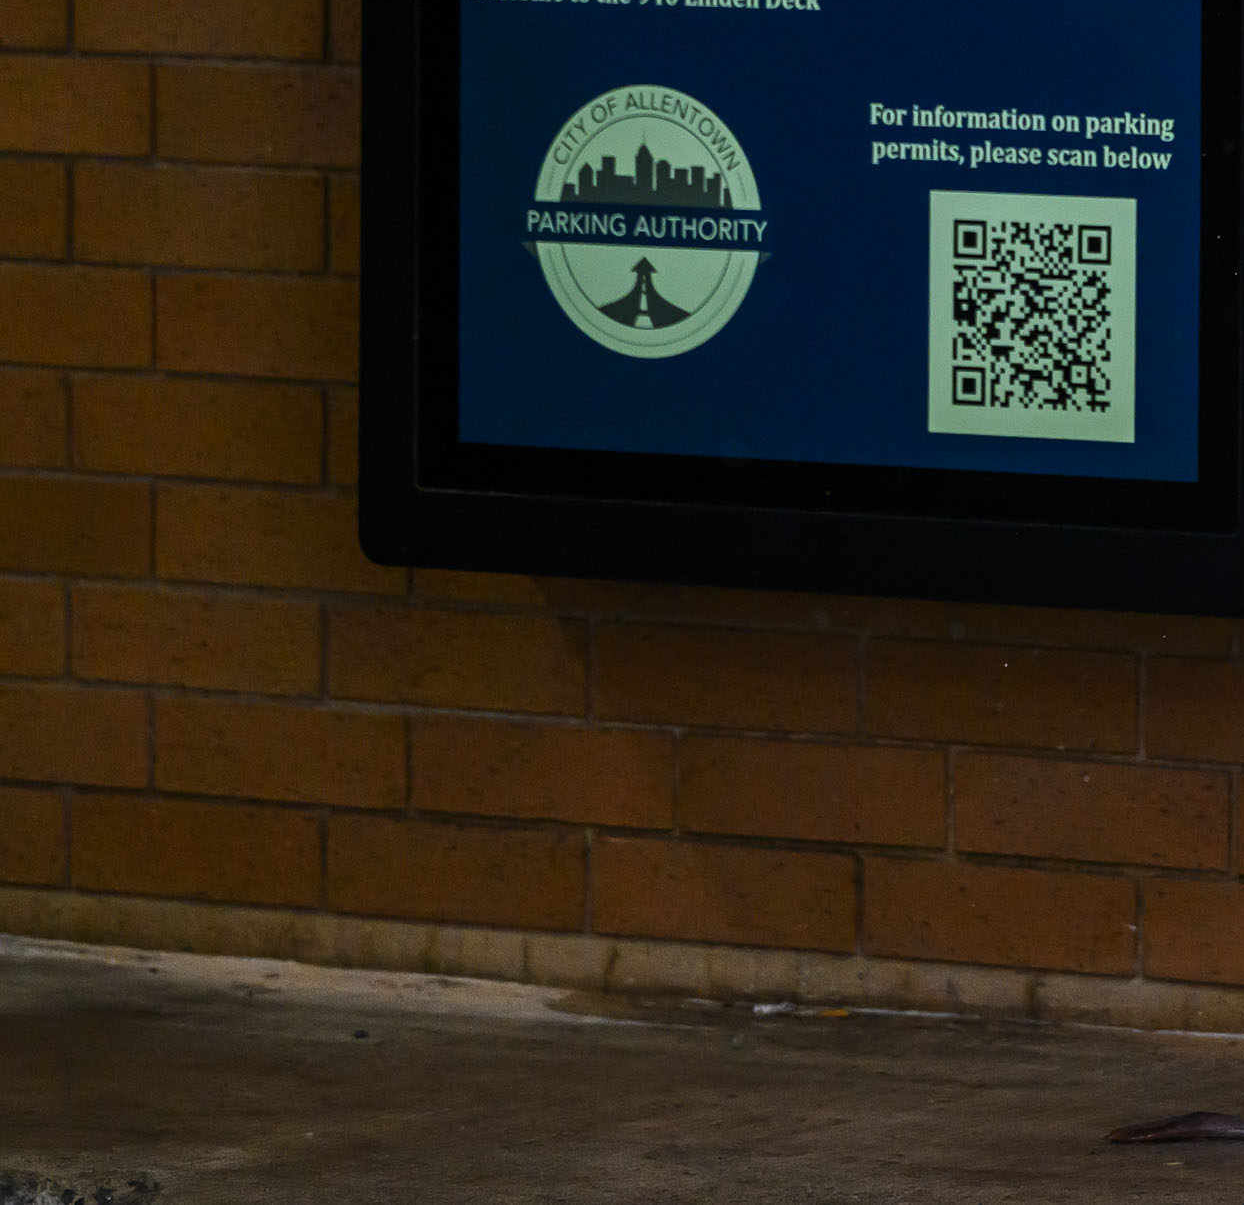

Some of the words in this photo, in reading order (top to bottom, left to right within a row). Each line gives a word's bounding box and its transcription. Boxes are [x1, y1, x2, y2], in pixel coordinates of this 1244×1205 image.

[553, 122, 589, 166] CITY
[591, 98, 620, 125] OF
[625, 92, 741, 171] ALLENTOWN
[871, 103, 907, 125] For
[913, 105, 1045, 131] information
[1052, 115, 1079, 132] on
[1086, 112, 1174, 141] parking
[873, 139, 964, 165] permits,
[971, 141, 1041, 168] please
[1047, 149, 1097, 167] scan
[1103, 146, 1172, 169] below
[528, 210, 626, 236] PARKING
[634, 216, 767, 241] AUTHORITY
